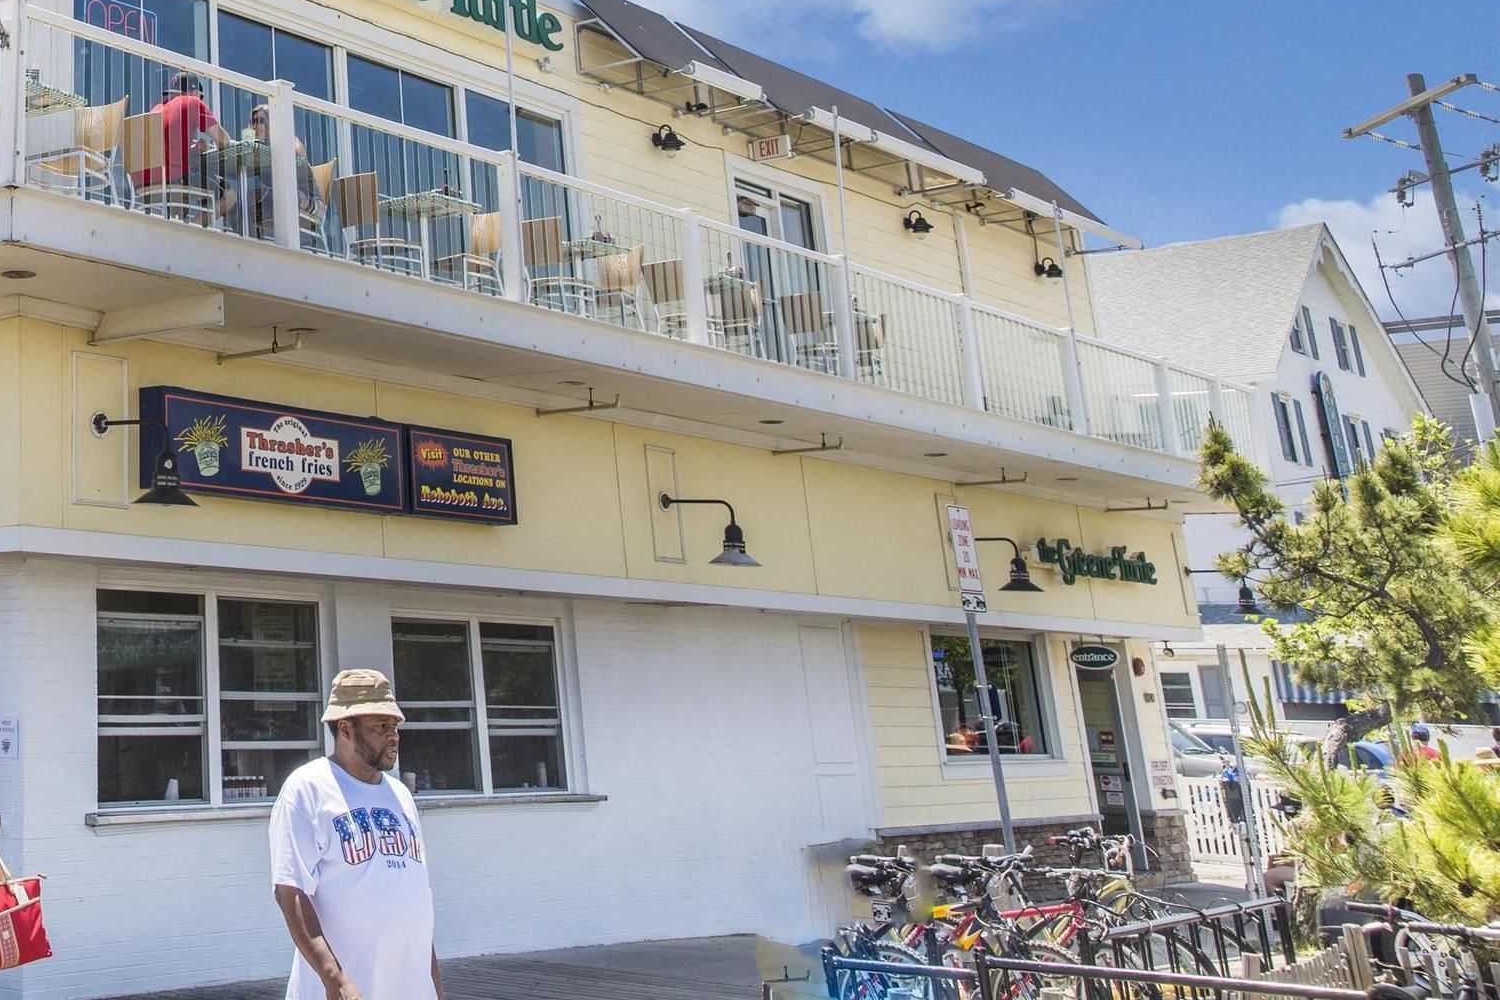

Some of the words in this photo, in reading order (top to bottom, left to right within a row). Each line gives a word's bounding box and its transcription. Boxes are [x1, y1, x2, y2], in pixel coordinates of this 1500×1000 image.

[87, 0, 154, 45] OPEN
[759, 138, 779, 157] EXIT
[274, 422, 283, 433] The
[285, 419, 308, 438] original
[246, 431, 334, 459] Thrasher's
[421, 448, 442, 460] Visit
[453, 448, 471, 459] OUR
[473, 450, 501, 462] OTHER
[248, 451, 294, 472] french
[301, 457, 333, 476] fries
[276, 475, 292, 490] since
[453, 474, 493, 488] LOCATIONS
[495, 479, 506, 488] ON
[420, 485, 478, 507] Rehoboth
[950, 518, 970, 531] LOADING
[957, 534, 970, 547] ZONE
[963, 551, 970, 563] 20
[1037, 537, 1058, 563] the
[1057, 538, 1116, 585] Greene
[1112, 545, 1158, 585] Turtle
[1072, 651, 1115, 662] entrance
[386, 860, 407, 869] 2014
